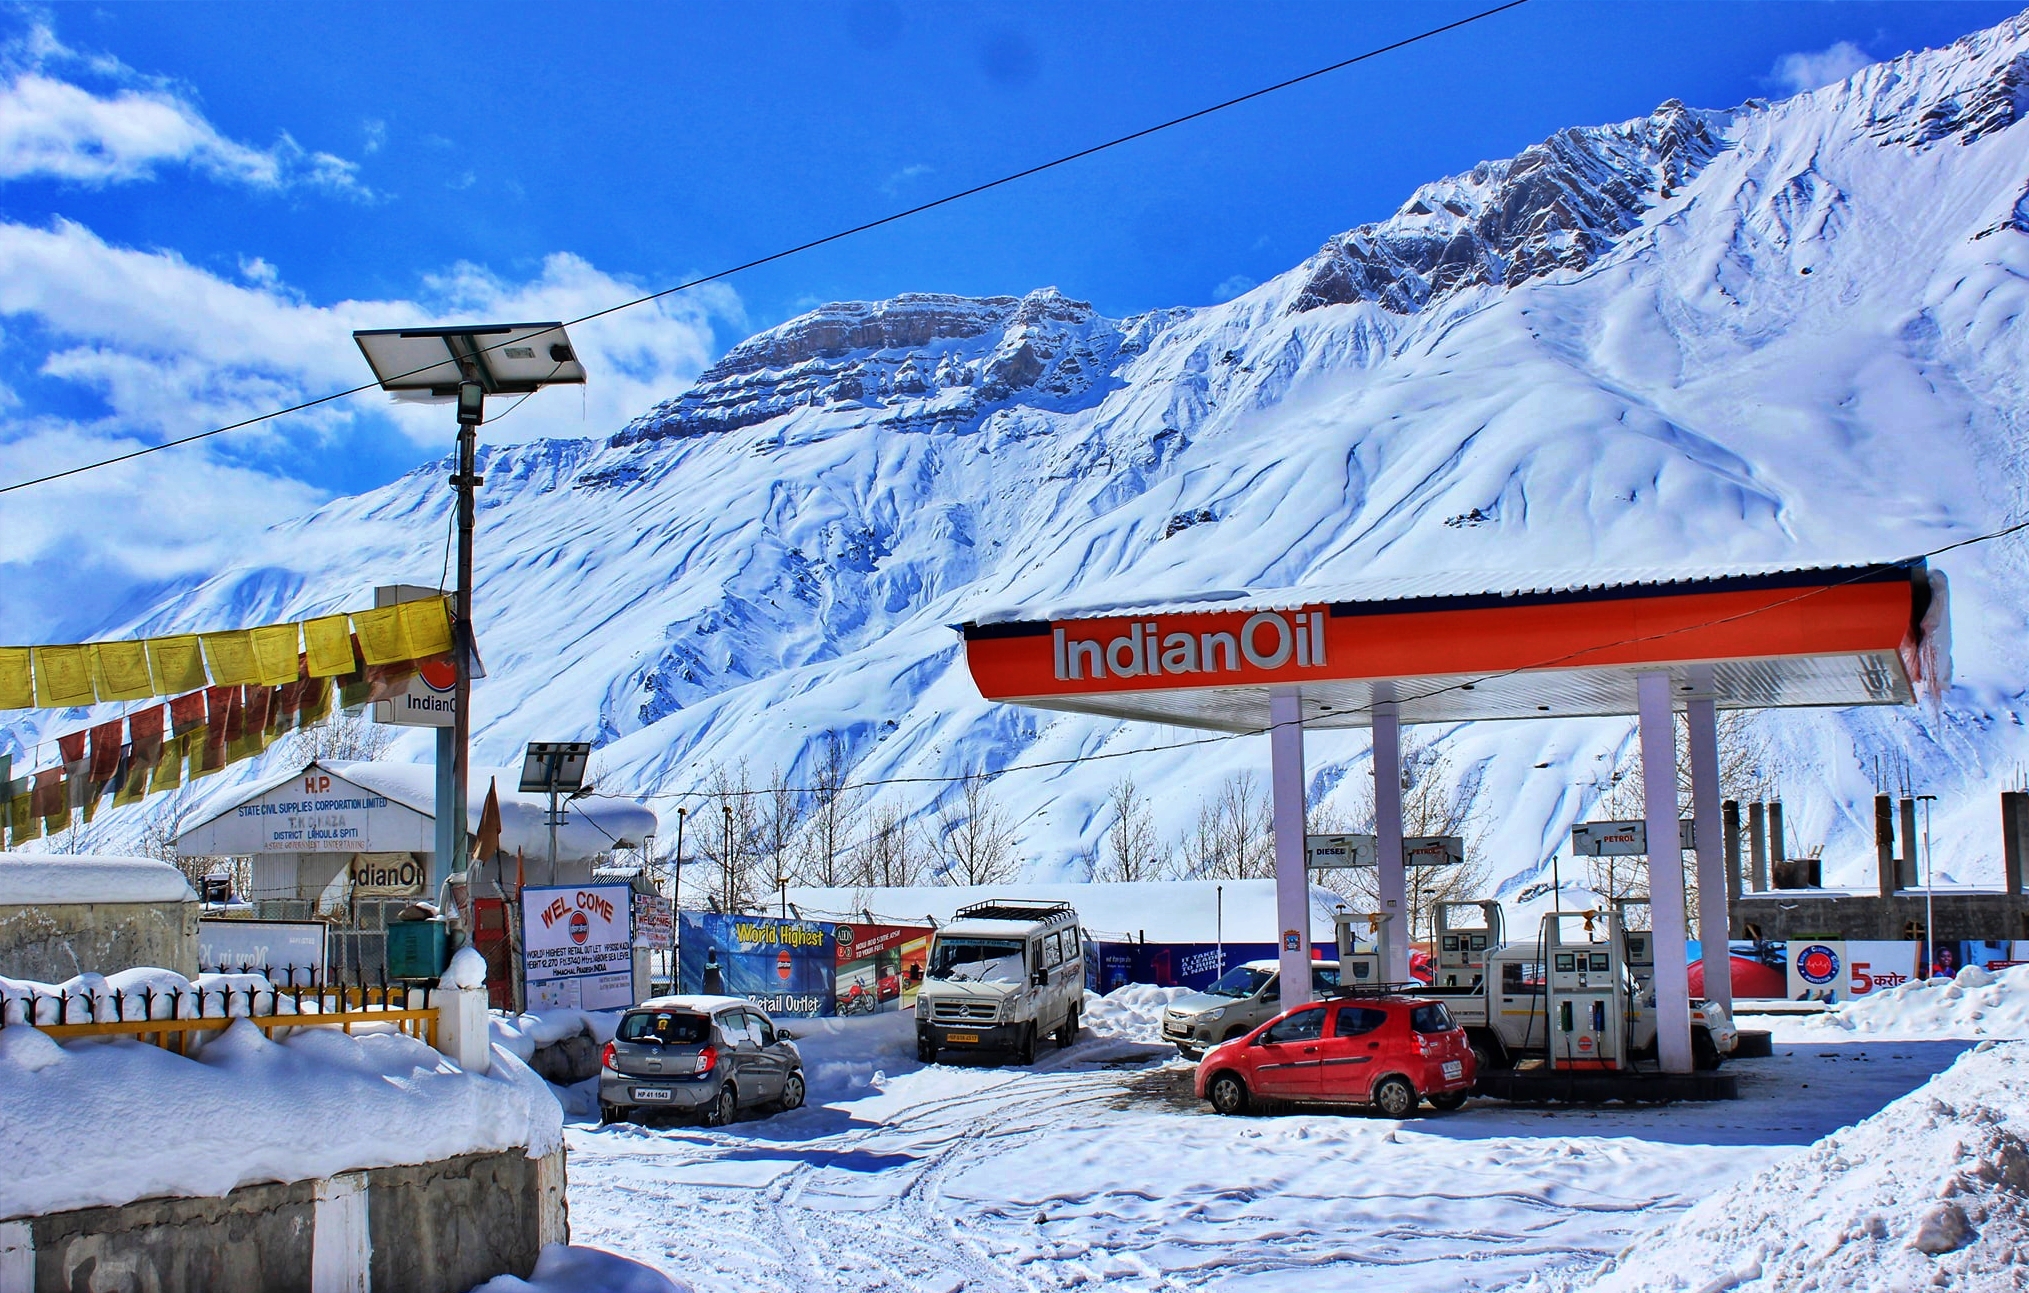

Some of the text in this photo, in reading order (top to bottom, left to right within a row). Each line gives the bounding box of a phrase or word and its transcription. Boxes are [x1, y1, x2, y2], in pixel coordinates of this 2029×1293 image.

[1053, 611, 1328, 682] IndianOil
[304, 776, 331, 794] H.P.
[238, 796, 388, 818] STATE CIVIL SUPPLIES CORPORATION LIMITED
[273, 830, 303, 841] DISTRICT
[339, 828, 359, 839] SPITI
[1603, 834, 1635, 843] PETROL
[1316, 847, 1346, 856] DIESEL
[735, 923, 824, 948] World Highest
[545, 947, 567, 957] HIGHEST
[567, 946, 584, 956] RETAIL
[616, 951, 630, 960] LEVEL
[1191, 961, 1226, 974] NATION
[1196, 960, 1216, 968] RUN
[1850, 962, 1873, 995] 5
[785, 994, 819, 1012] Outlet
[637, 1091, 668, 1099] HP 41 1543
